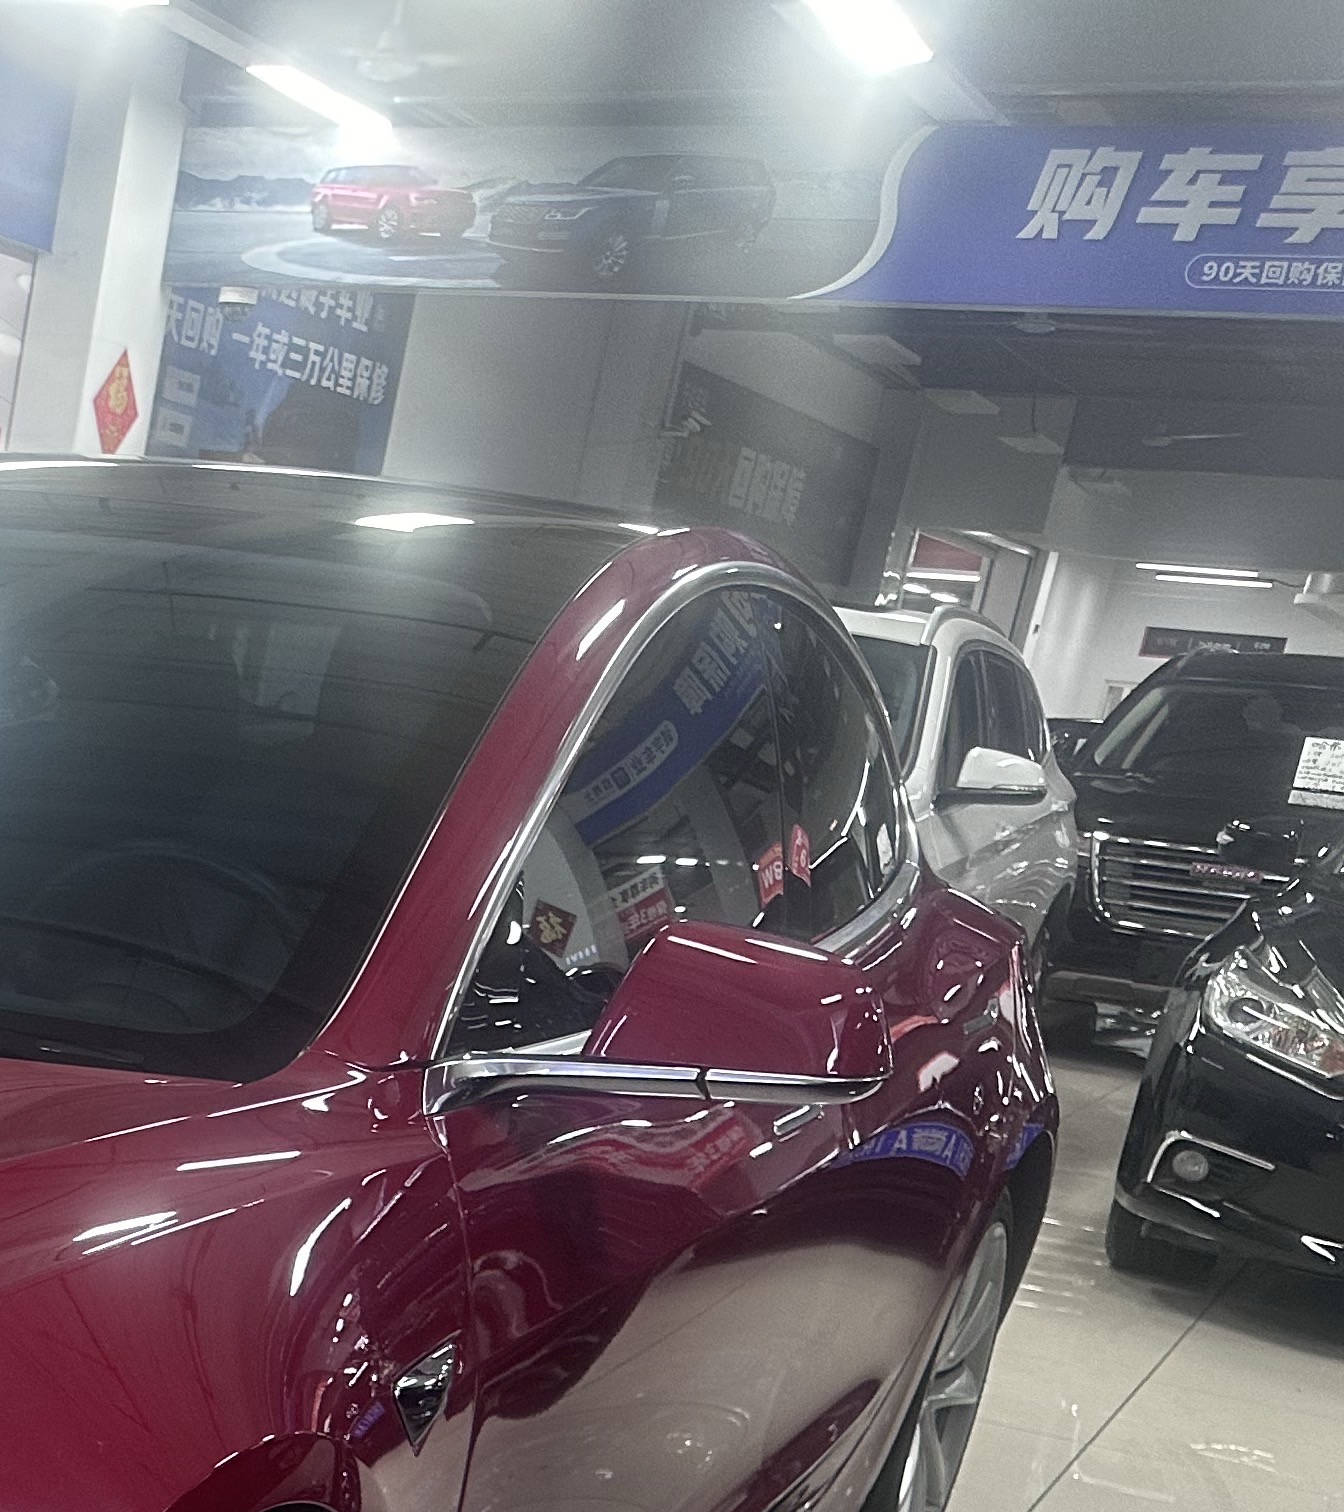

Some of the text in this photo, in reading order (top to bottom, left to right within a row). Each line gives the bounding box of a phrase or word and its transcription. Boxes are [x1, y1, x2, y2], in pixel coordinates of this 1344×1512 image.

[1201, 260, 1344, 286] 90天回购保
[231, 321, 391, 406] 一年或三万公里保修
